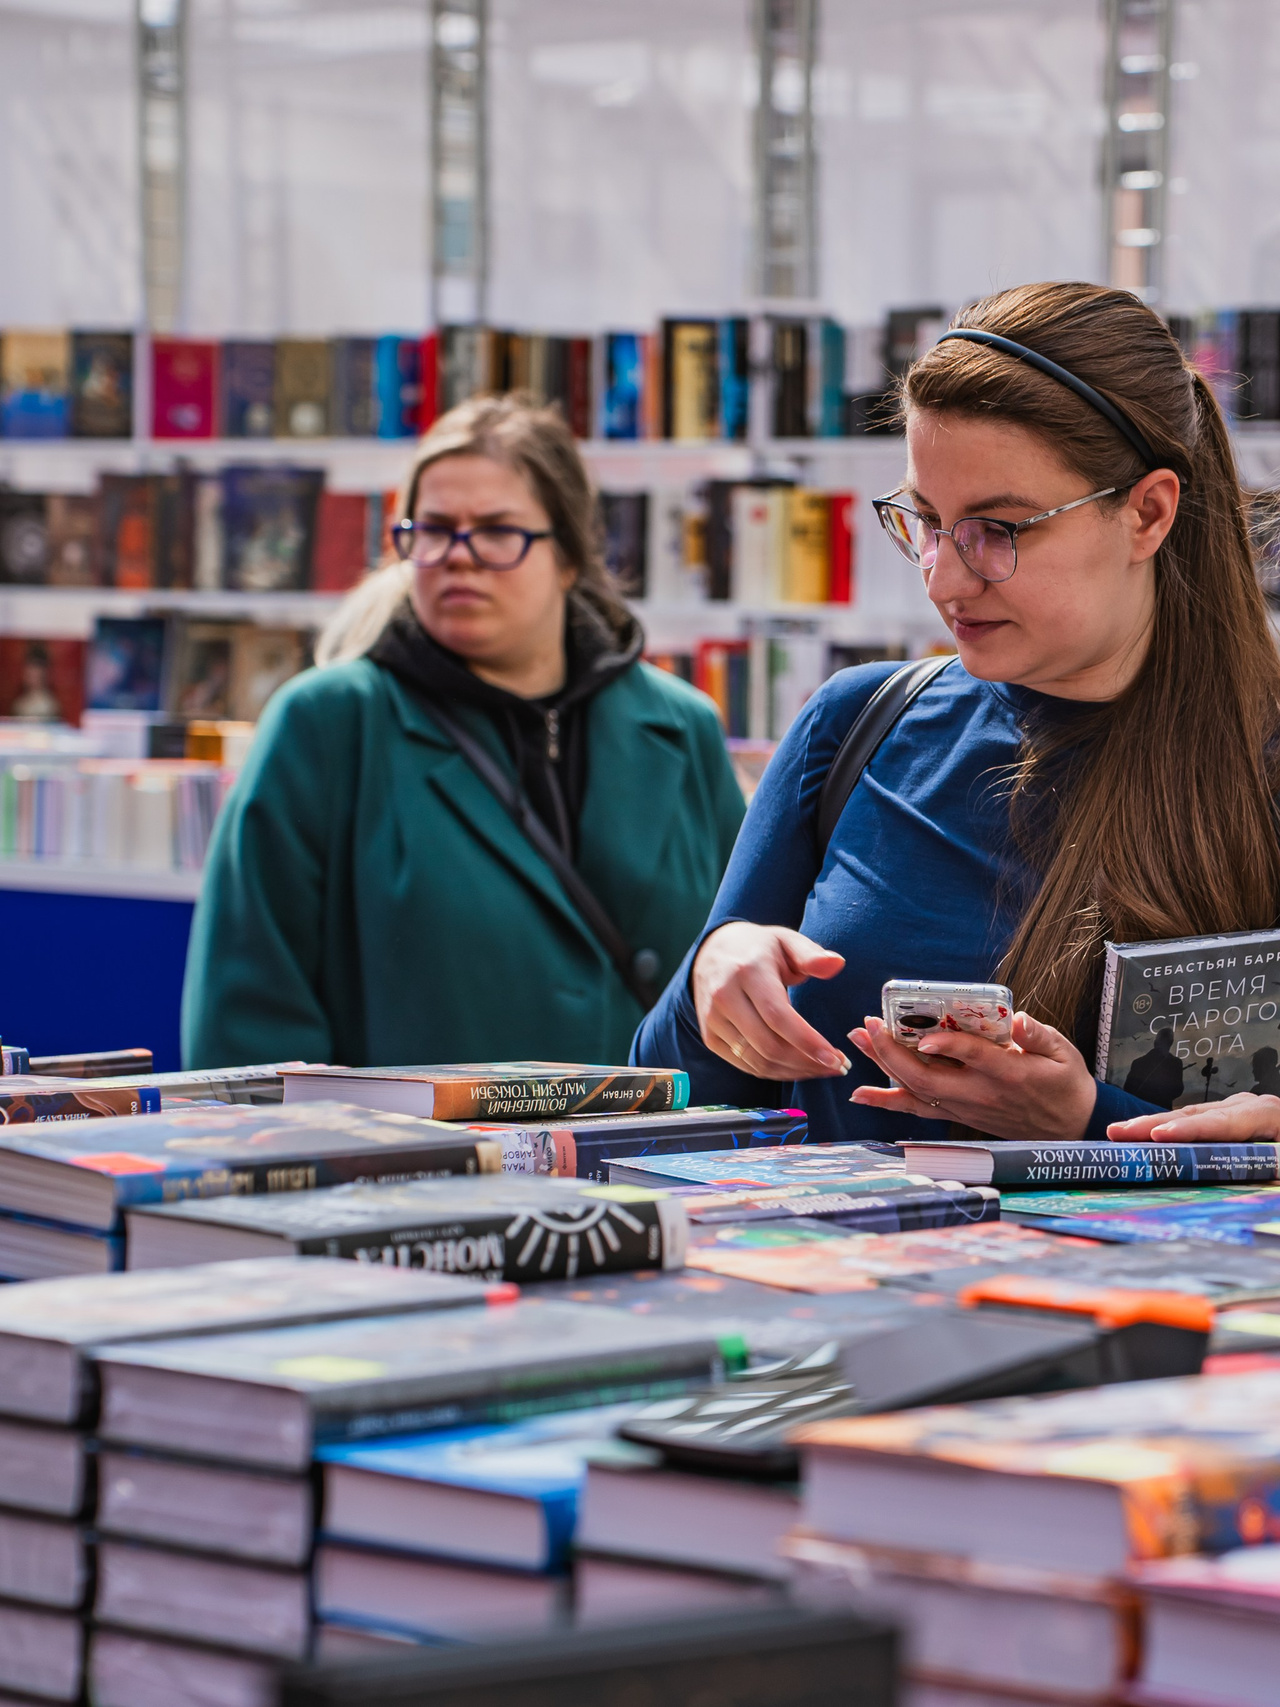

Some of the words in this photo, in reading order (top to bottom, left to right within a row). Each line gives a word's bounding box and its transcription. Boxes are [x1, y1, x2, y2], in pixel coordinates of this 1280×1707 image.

[1142, 957, 1237, 978] СЕБАСТЬЯН
[1168, 974, 1266, 1006] ВРЕМЯ
[1149, 1001, 1278, 1035] СТАРОГО
[1175, 1033, 1246, 1060] БОГА
[470, 1084, 528, 1100] ТОККЭБИ
[532, 1082, 586, 1097] МАГАЗИН
[635, 1089, 645, 1098] Ю
[487, 1098, 567, 1115] ВОЛШЕБНЫЙ
[34, 1114, 63, 1123] БАУЭР
[64, 1112, 90, 1121] АННА
[502, 1150, 537, 1160] ГАЙВОР
[1031, 1149, 1085, 1163] ЛАВОК
[1090, 1148, 1177, 1162] КНИЖНЫХ
[501, 1162, 526, 1172] МАЛЬ
[1026, 1165, 1129, 1180] ВОЛШЕБНЫХ
[1135, 1164, 1184, 1179] АЛЛЕЯ
